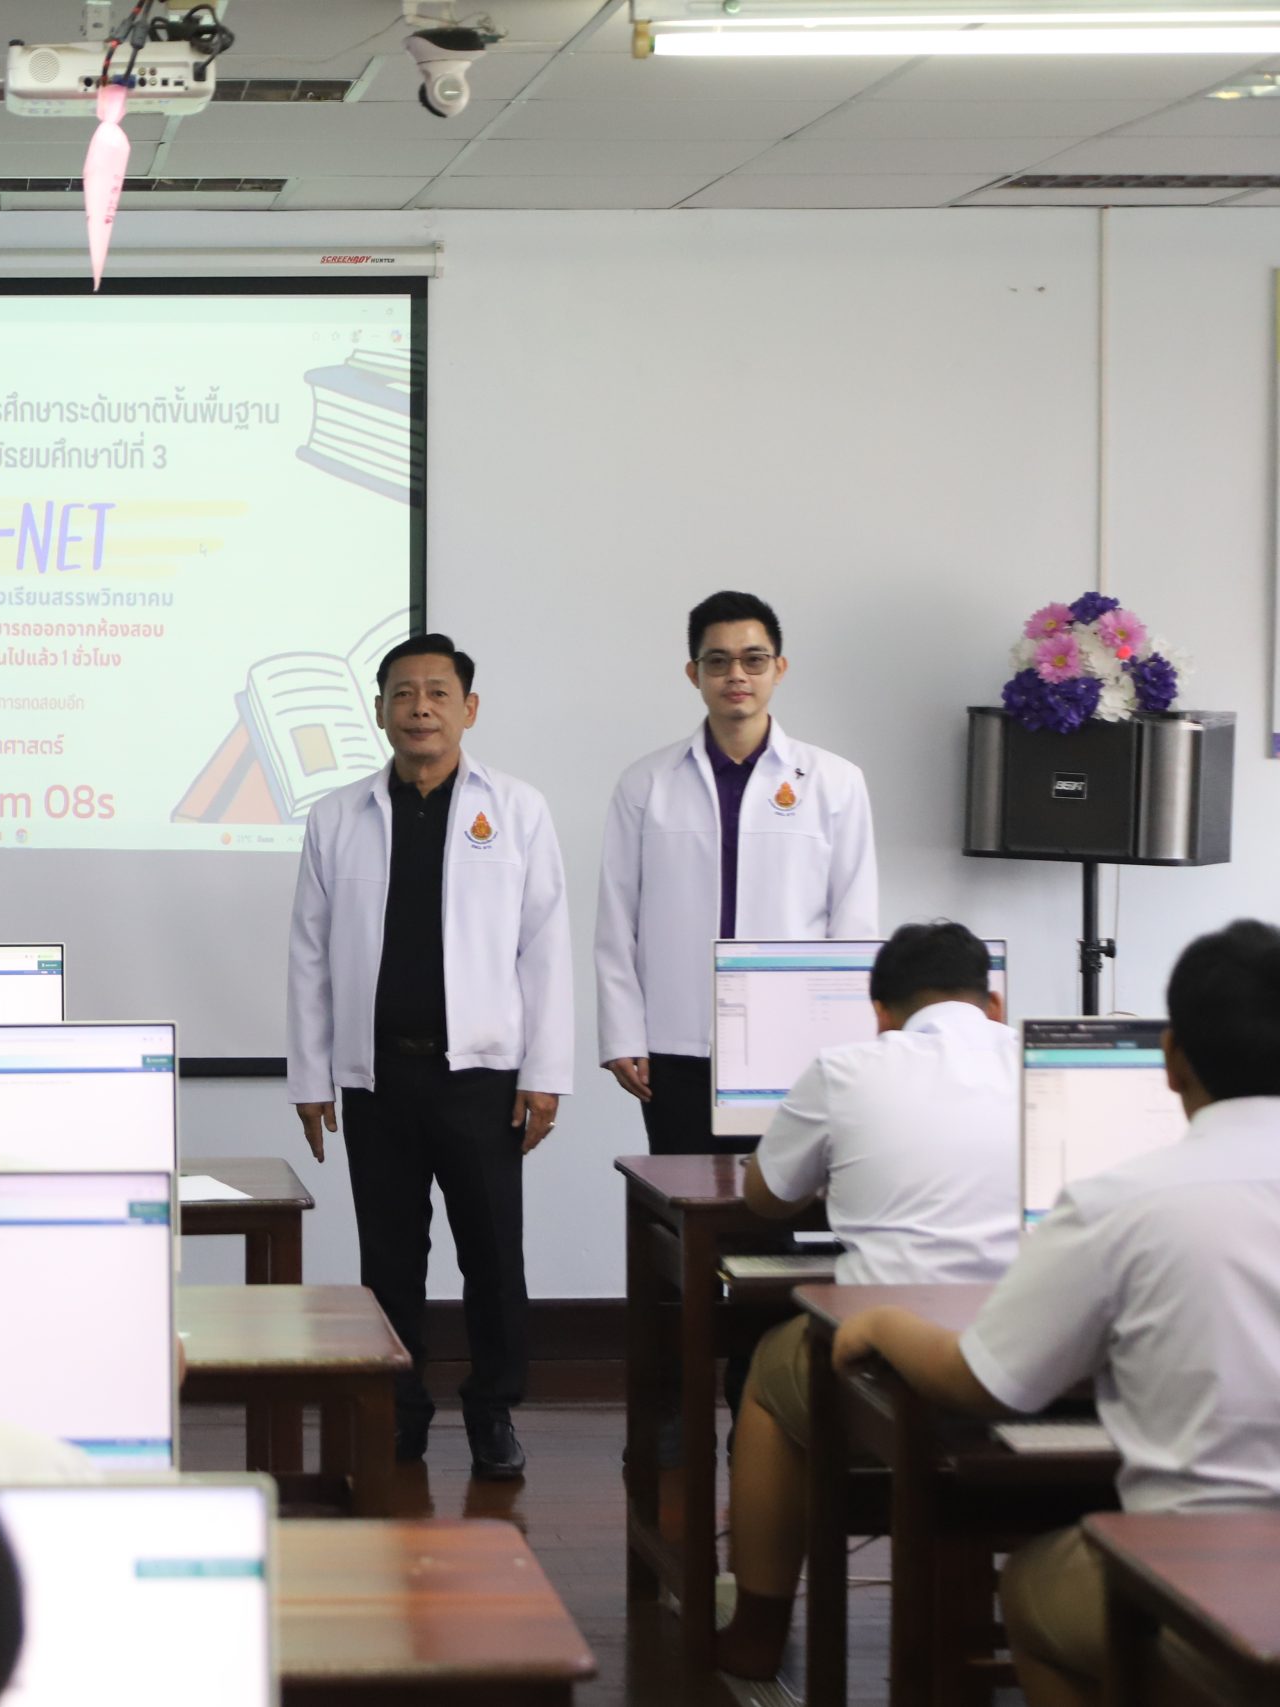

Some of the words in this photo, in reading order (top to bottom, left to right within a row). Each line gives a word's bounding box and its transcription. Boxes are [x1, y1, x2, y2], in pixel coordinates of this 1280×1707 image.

[152, 444, 167, 470] 3
[72, 644, 122, 668] ชั่วโมง
[43, 784, 116, 820] 08s
